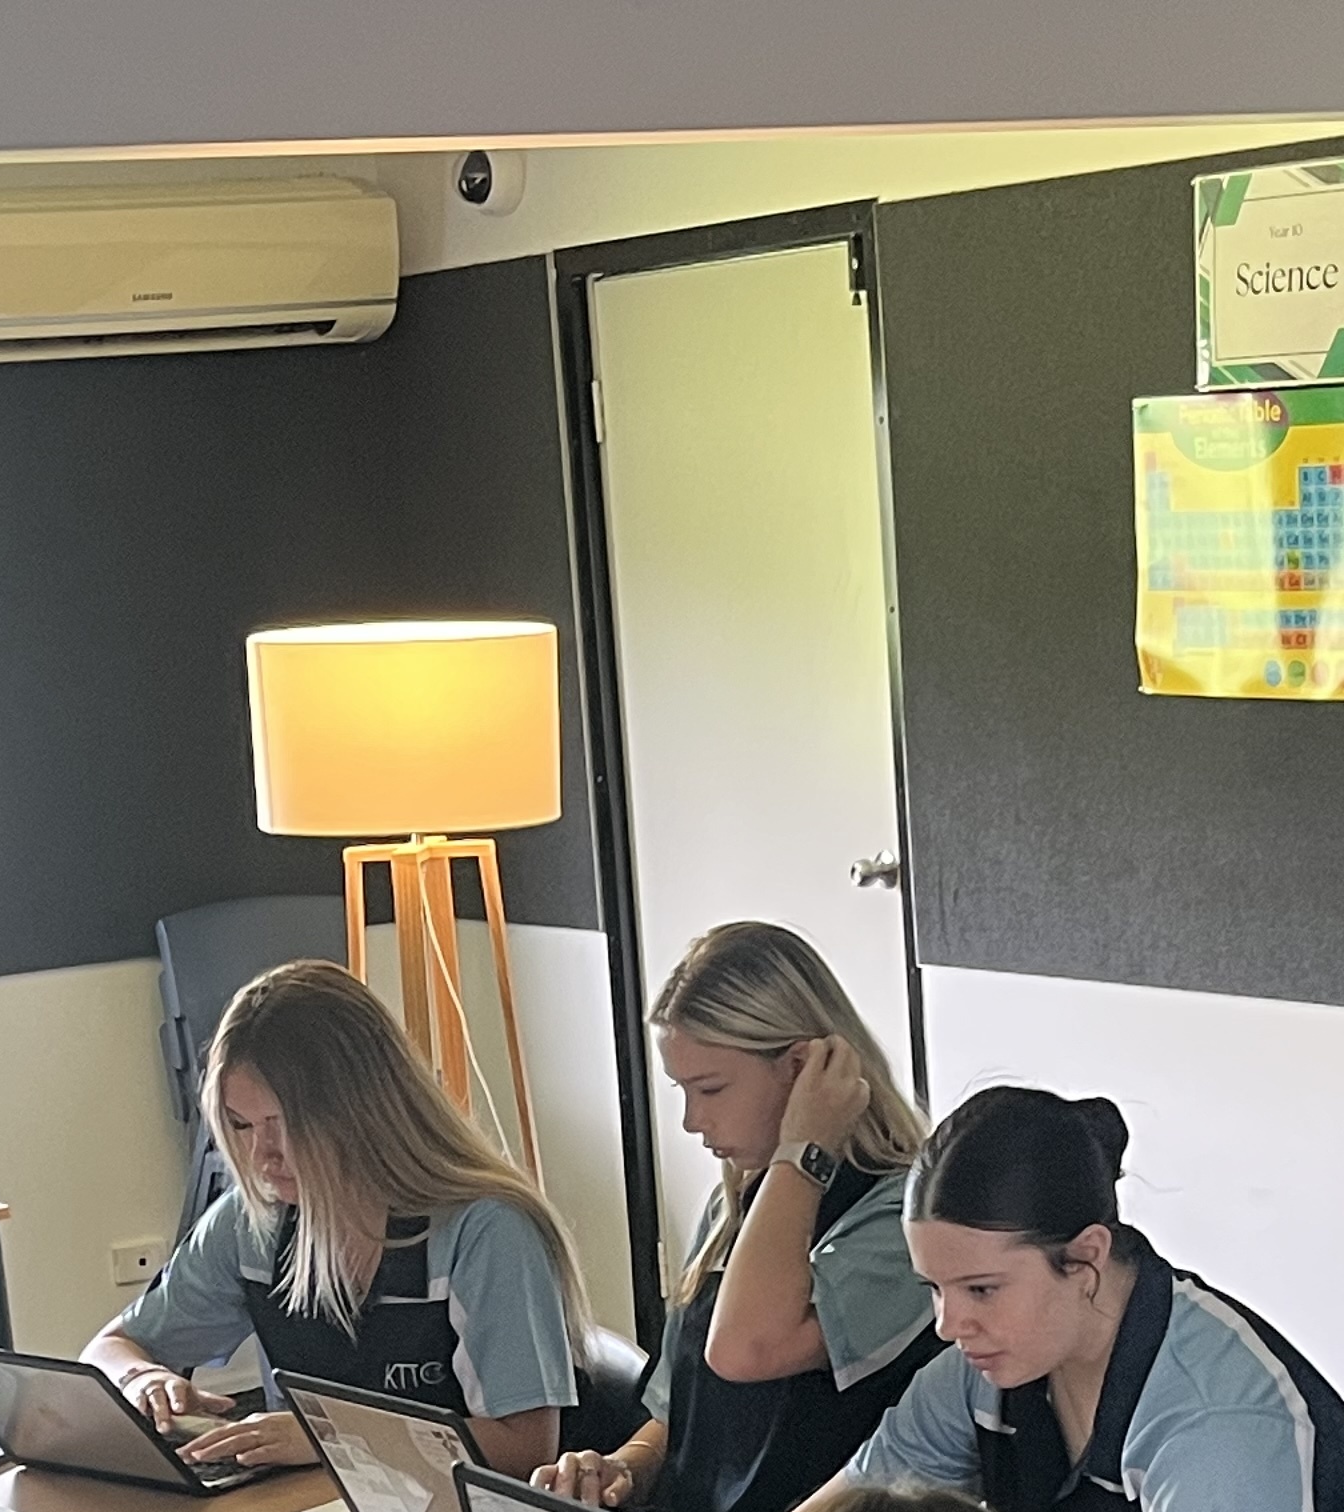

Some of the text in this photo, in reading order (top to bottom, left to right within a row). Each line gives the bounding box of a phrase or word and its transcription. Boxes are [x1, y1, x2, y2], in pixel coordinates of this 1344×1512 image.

[1269, 223, 1303, 239] Year 10
[1236, 262, 1339, 297] Science
[384, 1361, 447, 1390] KTTC
